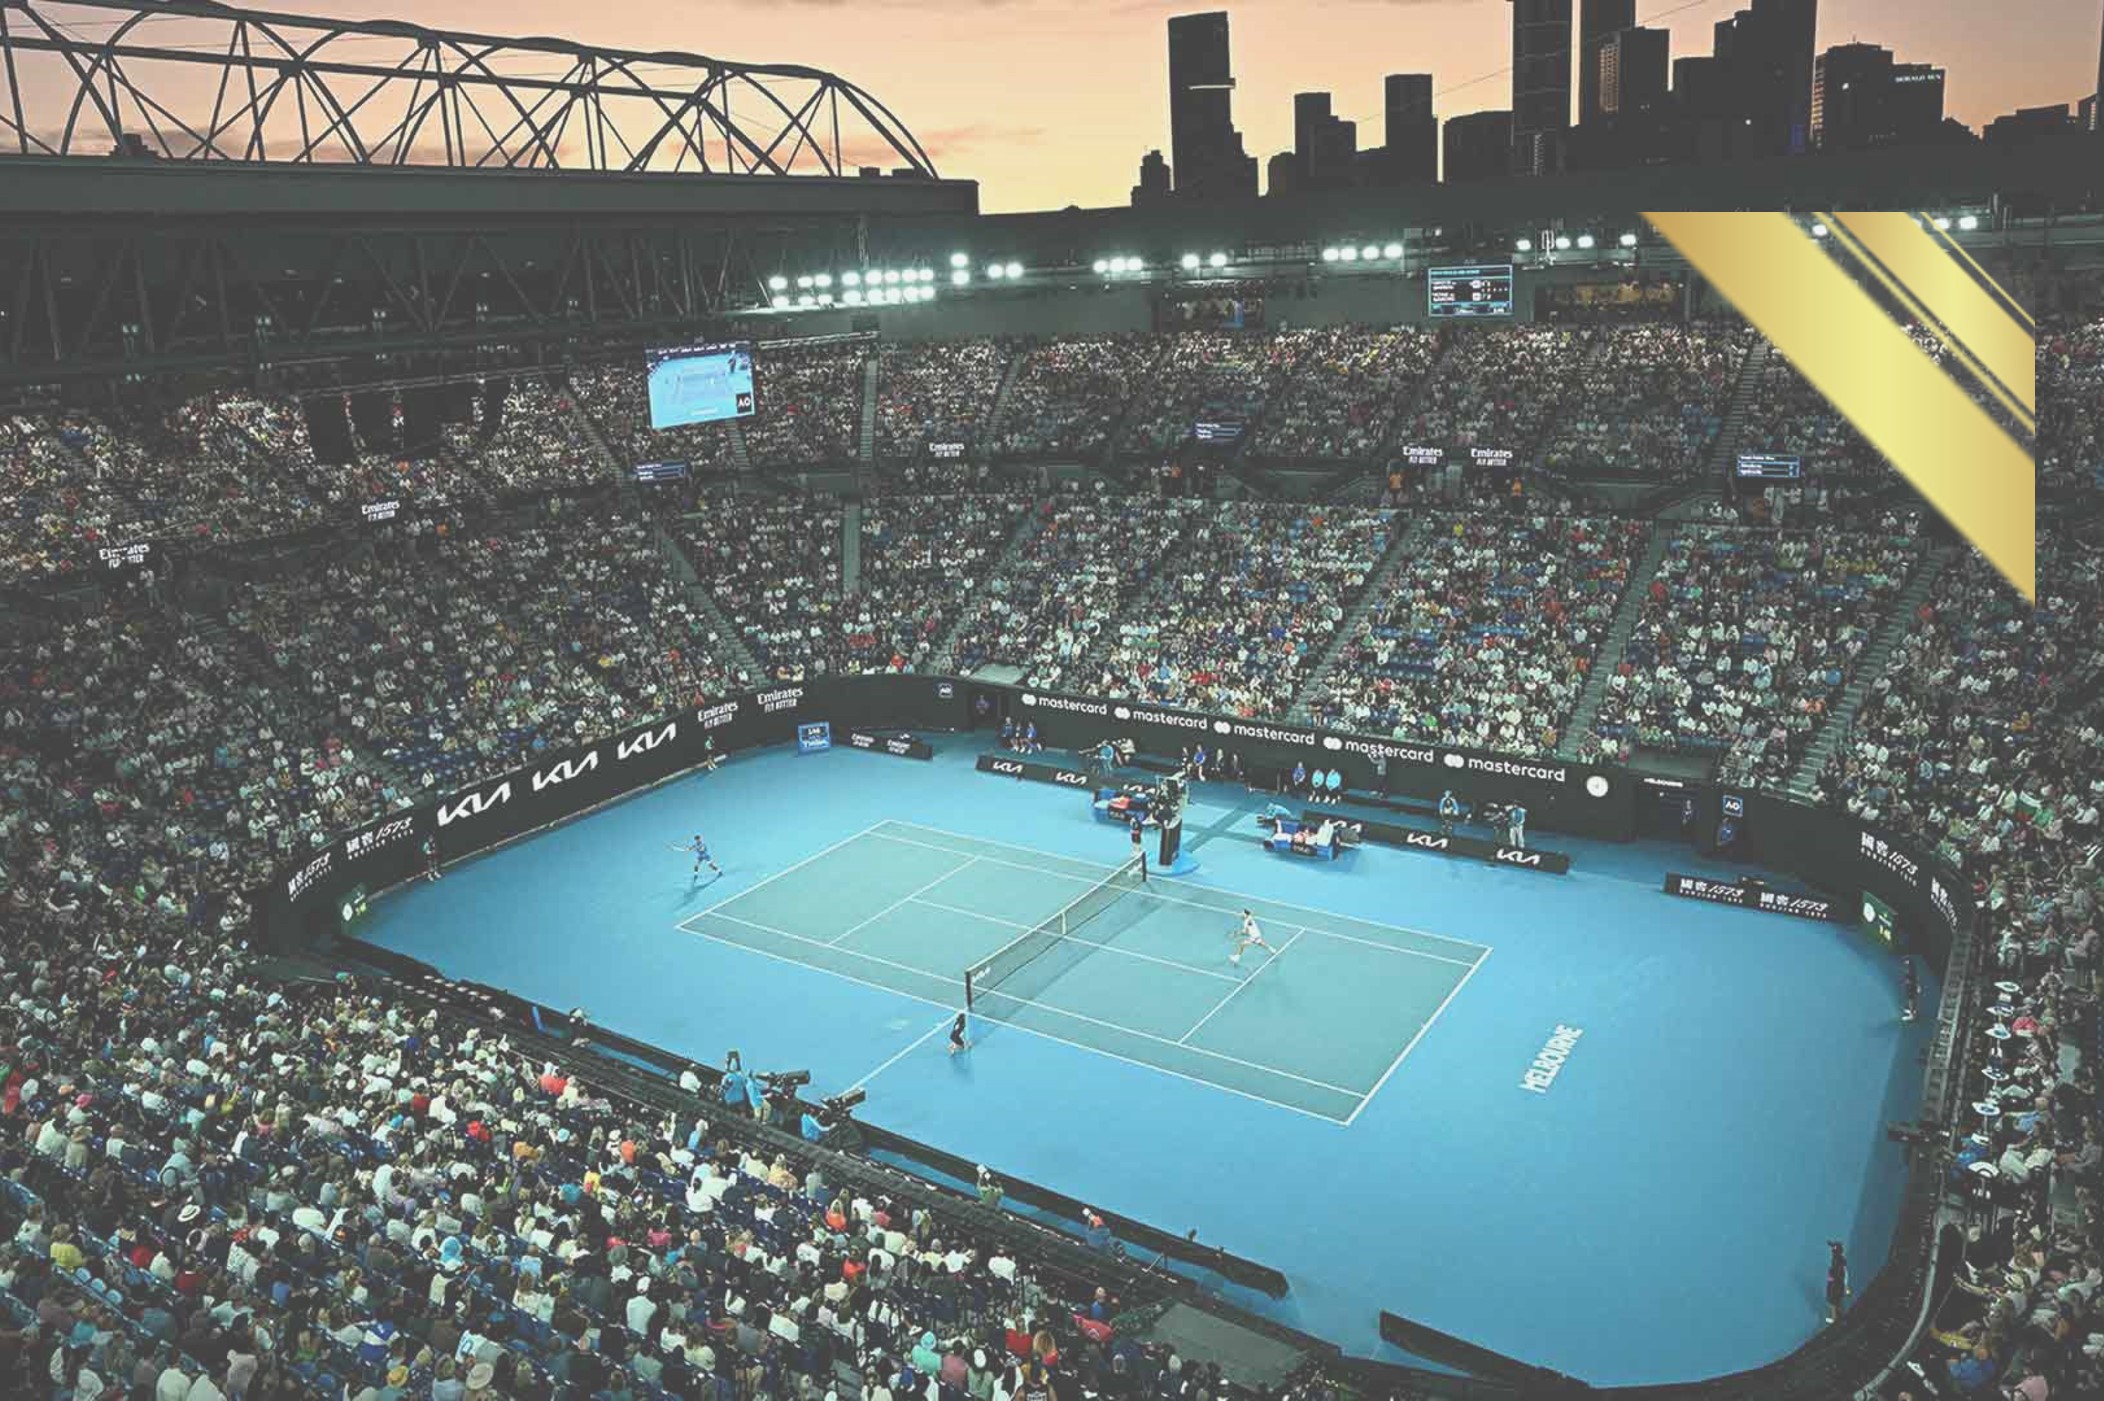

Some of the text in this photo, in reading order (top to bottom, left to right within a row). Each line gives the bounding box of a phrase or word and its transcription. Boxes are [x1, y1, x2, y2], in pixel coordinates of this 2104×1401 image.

[1402, 446, 1443, 457] Emirates
[1471, 448, 1513, 458] Emirates
[757, 687, 804, 705] Emirates
[1038, 696, 1107, 716] mastercard
[697, 701, 738, 722] Emirates
[1133, 708, 1208, 730] mastercard
[616, 722, 677, 760] KIA
[1233, 721, 1316, 746] mastercard
[1345, 739, 1435, 763] mastercard
[531, 750, 599, 792] KIA
[992, 760, 1023, 774] KIA
[1467, 756, 1566, 783] mastercard
[1055, 771, 1088, 785] KIA
[437, 781, 512, 827] KIA
[1406, 832, 1449, 849] KIA
[1496, 848, 1541, 865] KIA
[1518, 1024, 1583, 1094] MELBOURNE
